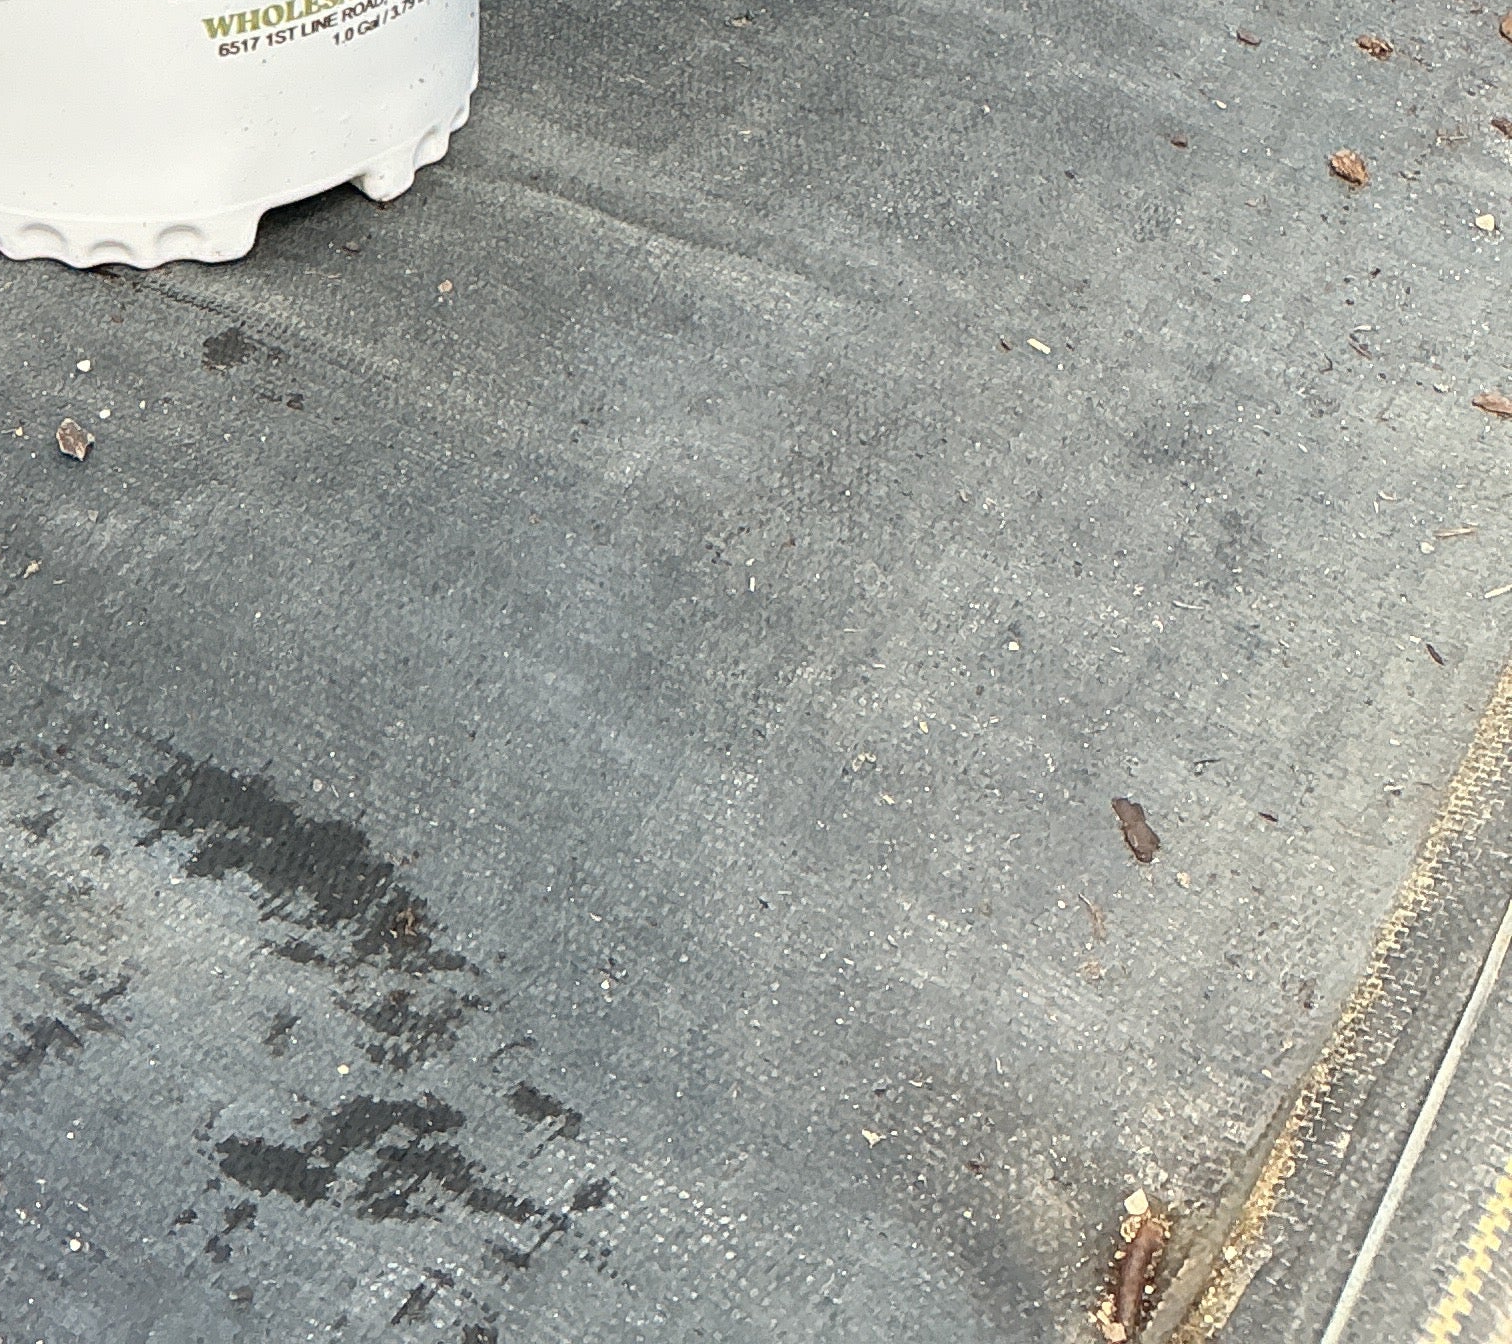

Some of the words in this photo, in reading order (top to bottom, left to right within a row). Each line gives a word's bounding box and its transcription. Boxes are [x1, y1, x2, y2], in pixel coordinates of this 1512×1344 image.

[219, 37, 260, 57] 6517
[266, 26, 298, 46] 1ST
[301, 12, 338, 37] LINE
[333, 27, 354, 46] 1.0
